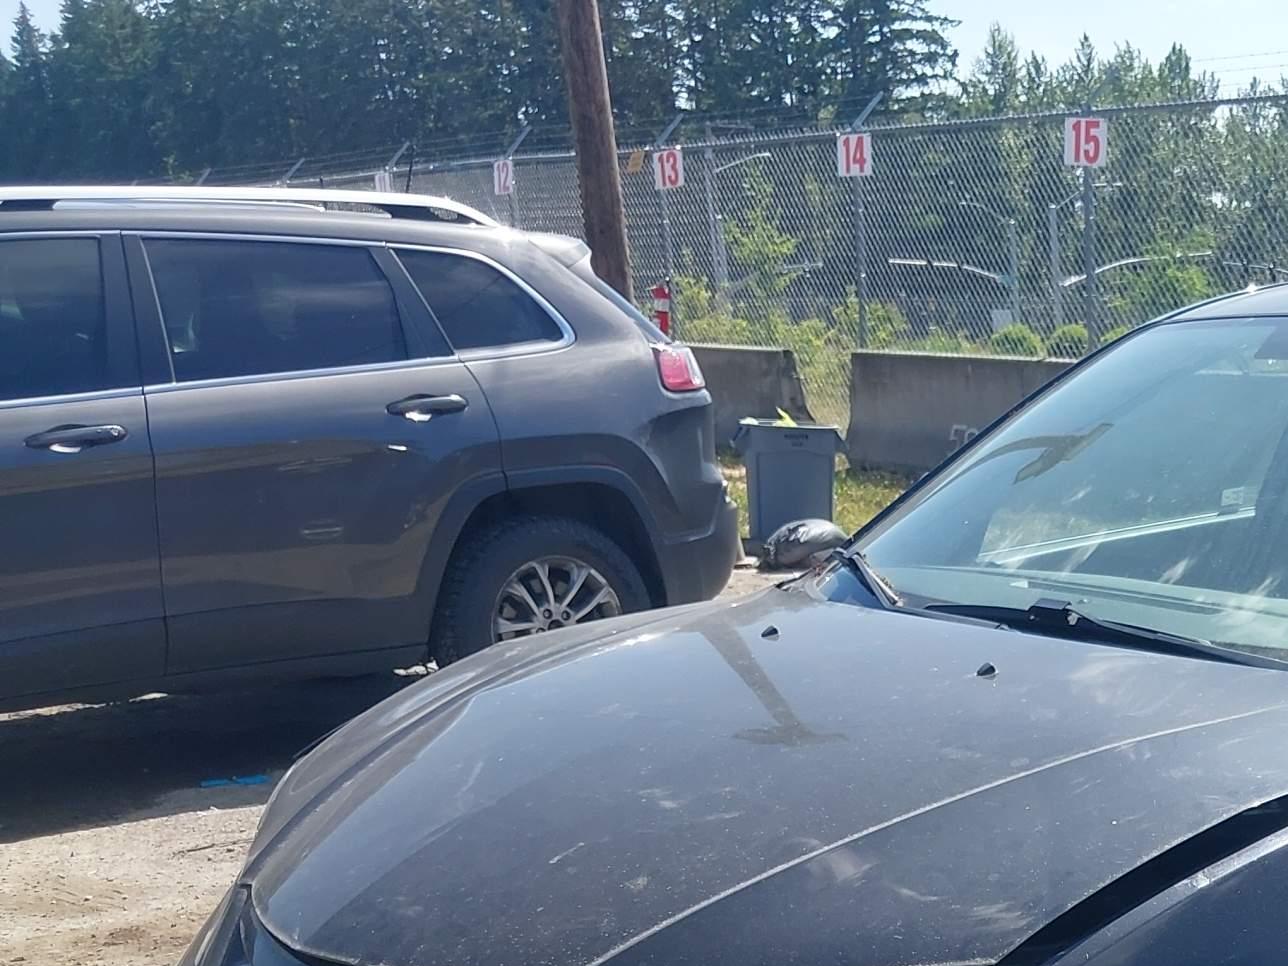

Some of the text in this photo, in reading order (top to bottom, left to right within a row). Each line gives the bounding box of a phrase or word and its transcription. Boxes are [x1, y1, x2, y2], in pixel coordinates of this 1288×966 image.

[842, 135, 867, 175] 14
[1072, 120, 1100, 164] 15
[496, 162, 510, 192] 12
[657, 150, 680, 188] 13
